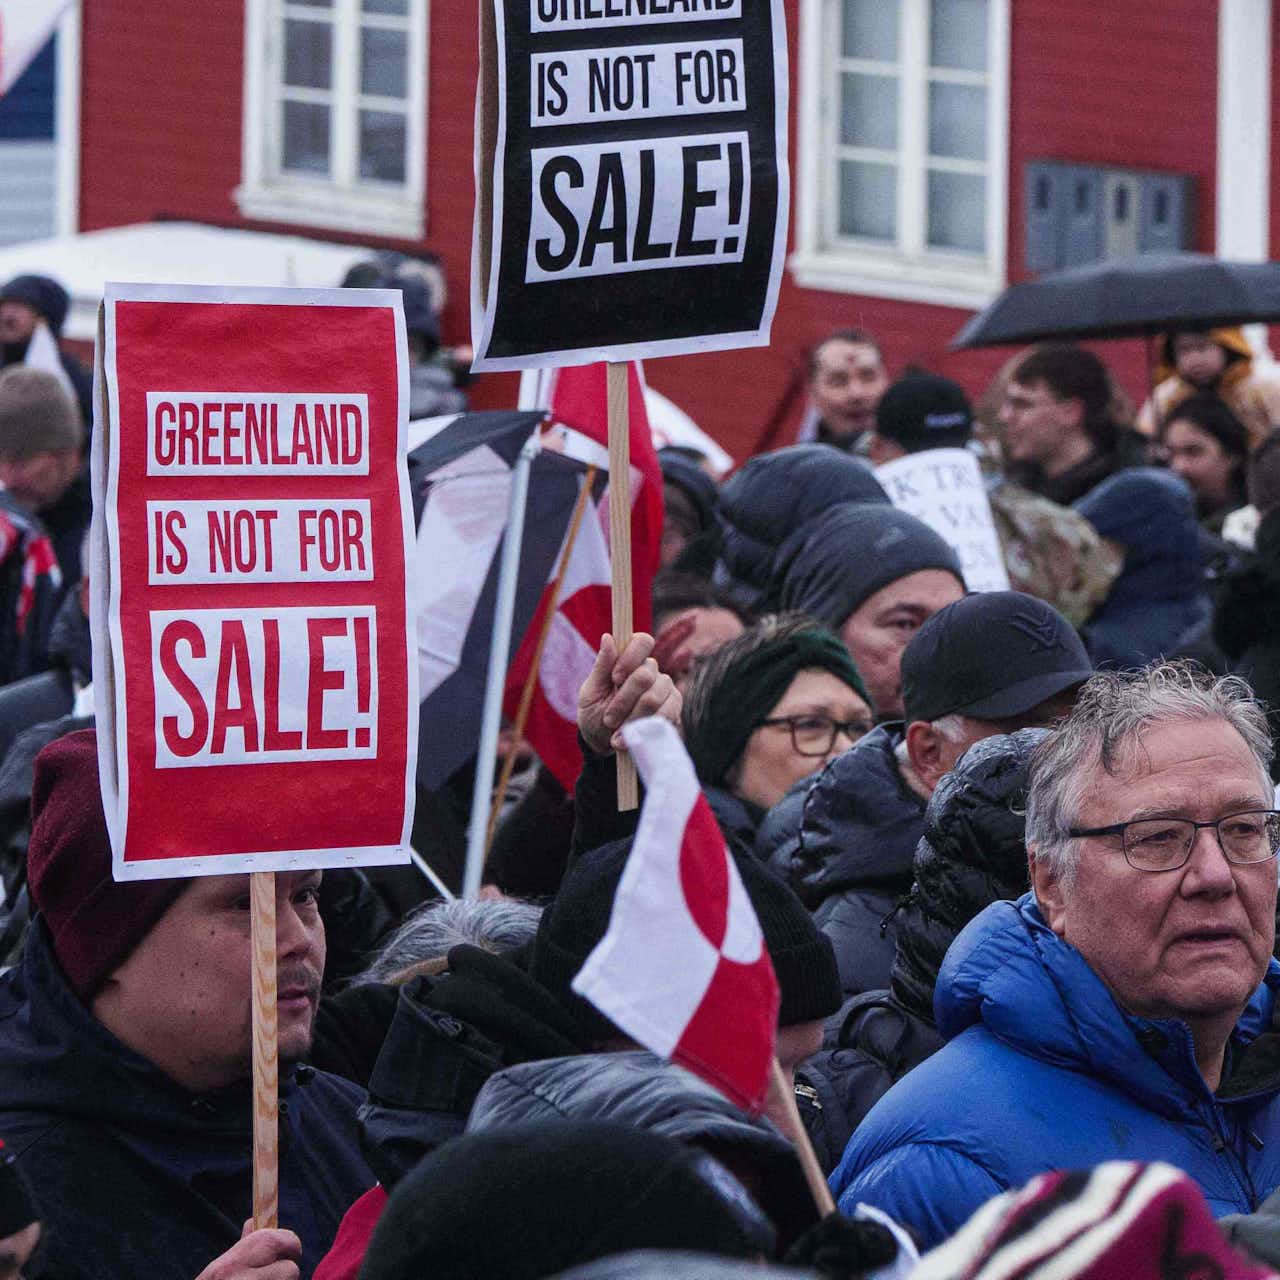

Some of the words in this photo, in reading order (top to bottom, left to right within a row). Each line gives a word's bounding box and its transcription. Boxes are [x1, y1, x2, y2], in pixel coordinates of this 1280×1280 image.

[537, 60, 568, 118] IS
[588, 53, 656, 113] NOT
[674, 48, 739, 106] FOR
[534, 141, 744, 273] SALE!
[154, 401, 363, 466] GREENLAND
[154, 510, 189, 575] IS
[207, 509, 278, 574] NOT
[298, 508, 366, 572] FOR
[159, 616, 372, 758] SALE!
